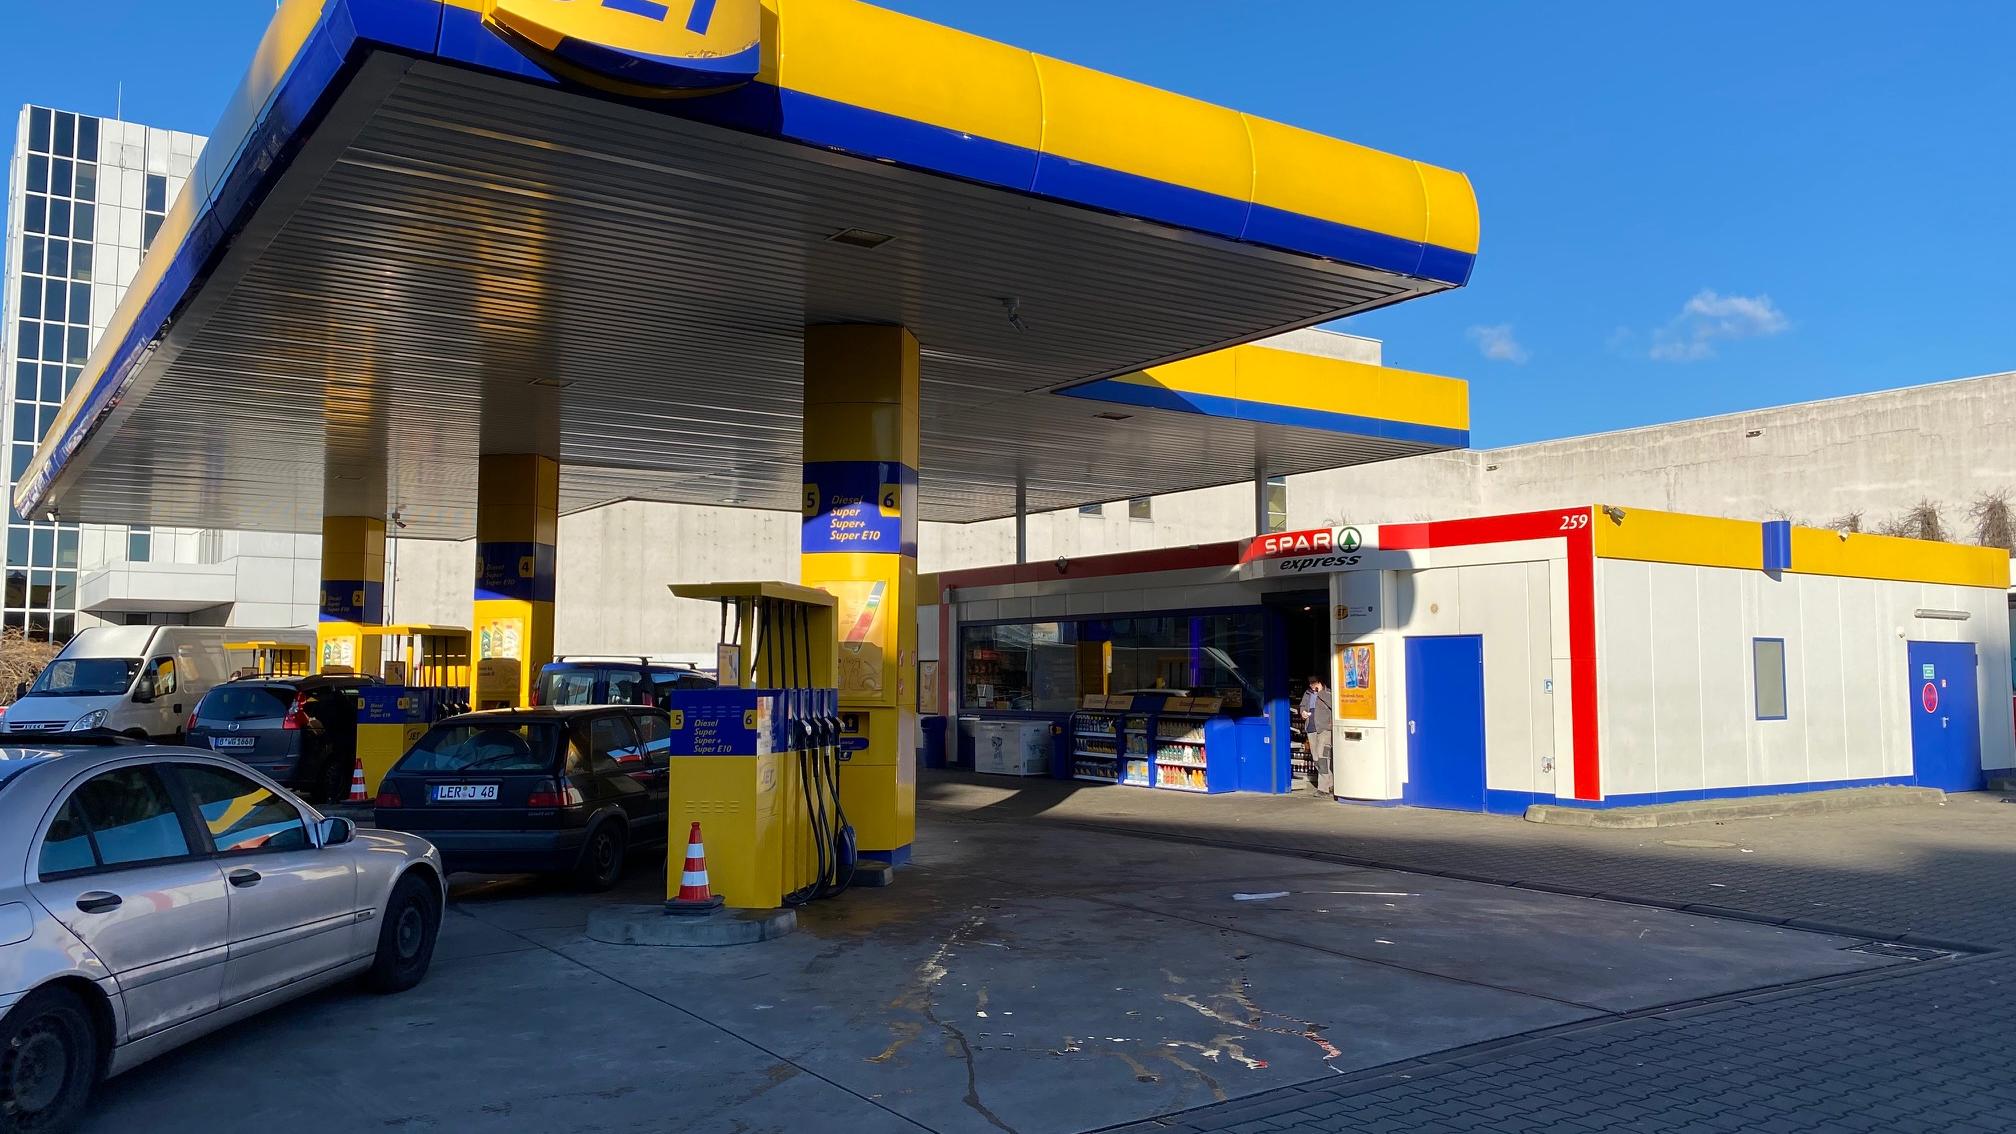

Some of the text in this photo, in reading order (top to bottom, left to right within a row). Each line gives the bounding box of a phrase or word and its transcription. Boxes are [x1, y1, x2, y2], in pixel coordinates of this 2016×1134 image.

[806, 492, 816, 508] 5
[831, 495, 864, 505] Diesel
[883, 491, 894, 508] 6
[830, 507, 861, 519] Super
[830, 519, 866, 530] Super+
[1560, 514, 1588, 530] 259
[830, 530, 881, 542] Super E10
[1265, 532, 1331, 554] SPAR
[522, 561, 529, 572] 4
[1280, 555, 1362, 572] express
[355, 594, 361, 602] 2
[675, 714, 682, 725] 5
[694, 719, 719, 727] Diesel
[745, 714, 752, 724] 6
[693, 728, 717, 737] Super
[693, 736, 716, 746] Super
[693, 745, 732, 755] Super E10
[440, 786, 495, 798] LER J 48
